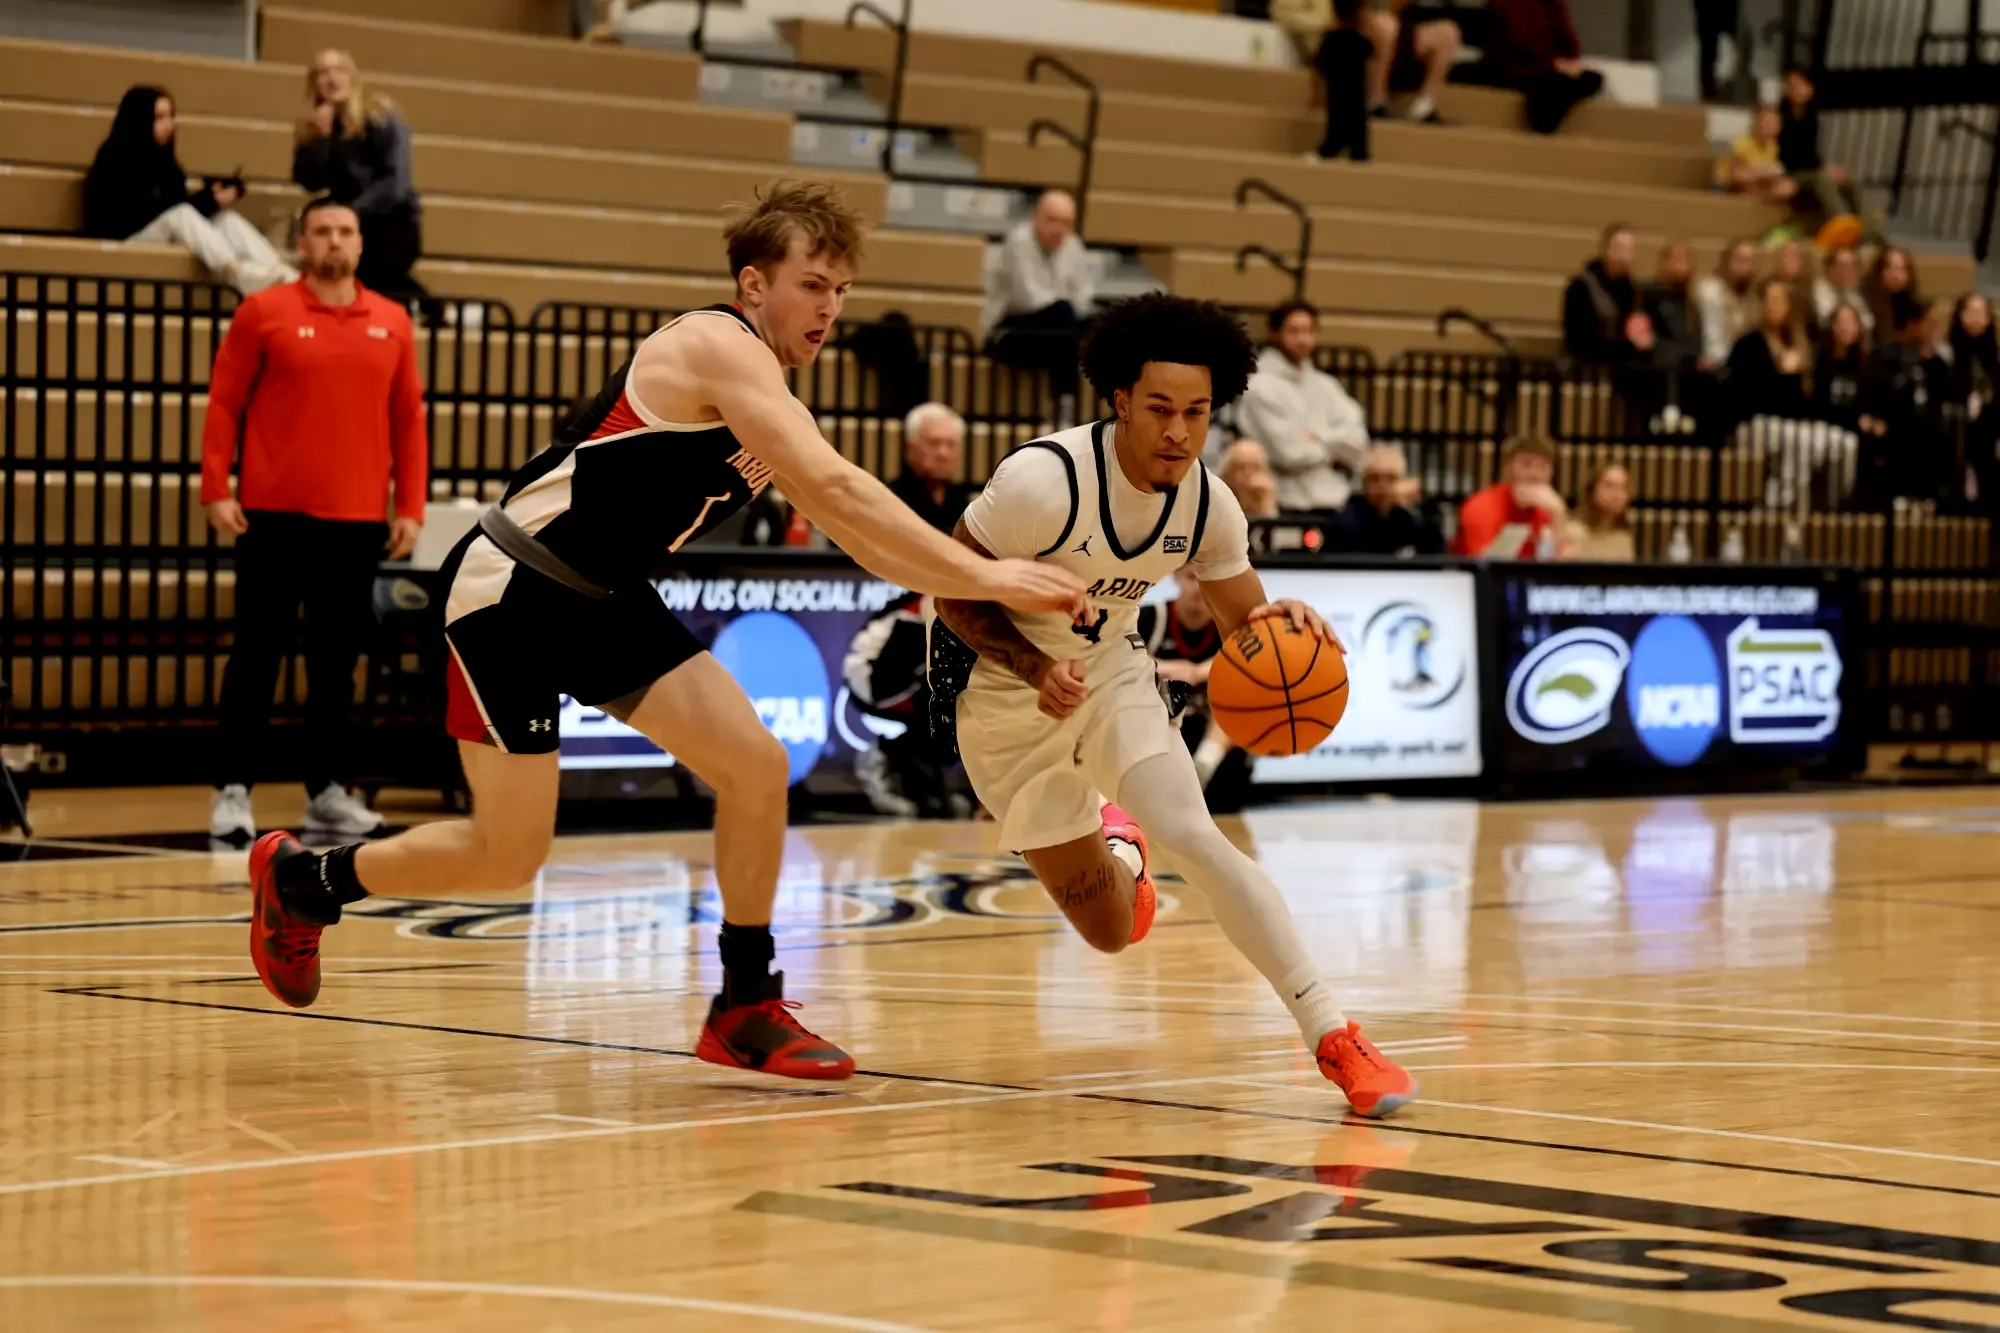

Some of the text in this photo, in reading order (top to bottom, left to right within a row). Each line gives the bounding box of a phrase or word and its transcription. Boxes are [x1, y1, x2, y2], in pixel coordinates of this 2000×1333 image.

[1163, 540, 1188, 549] PSAC
[701, 579, 736, 611] US
[737, 579, 776, 611] ON
[775, 579, 856, 611] SOCIAL
[1087, 578, 1156, 600] ARIO
[1737, 664, 1829, 703] PSAC
[754, 696, 828, 745] CAA
[1065, 863, 1116, 906] Family
